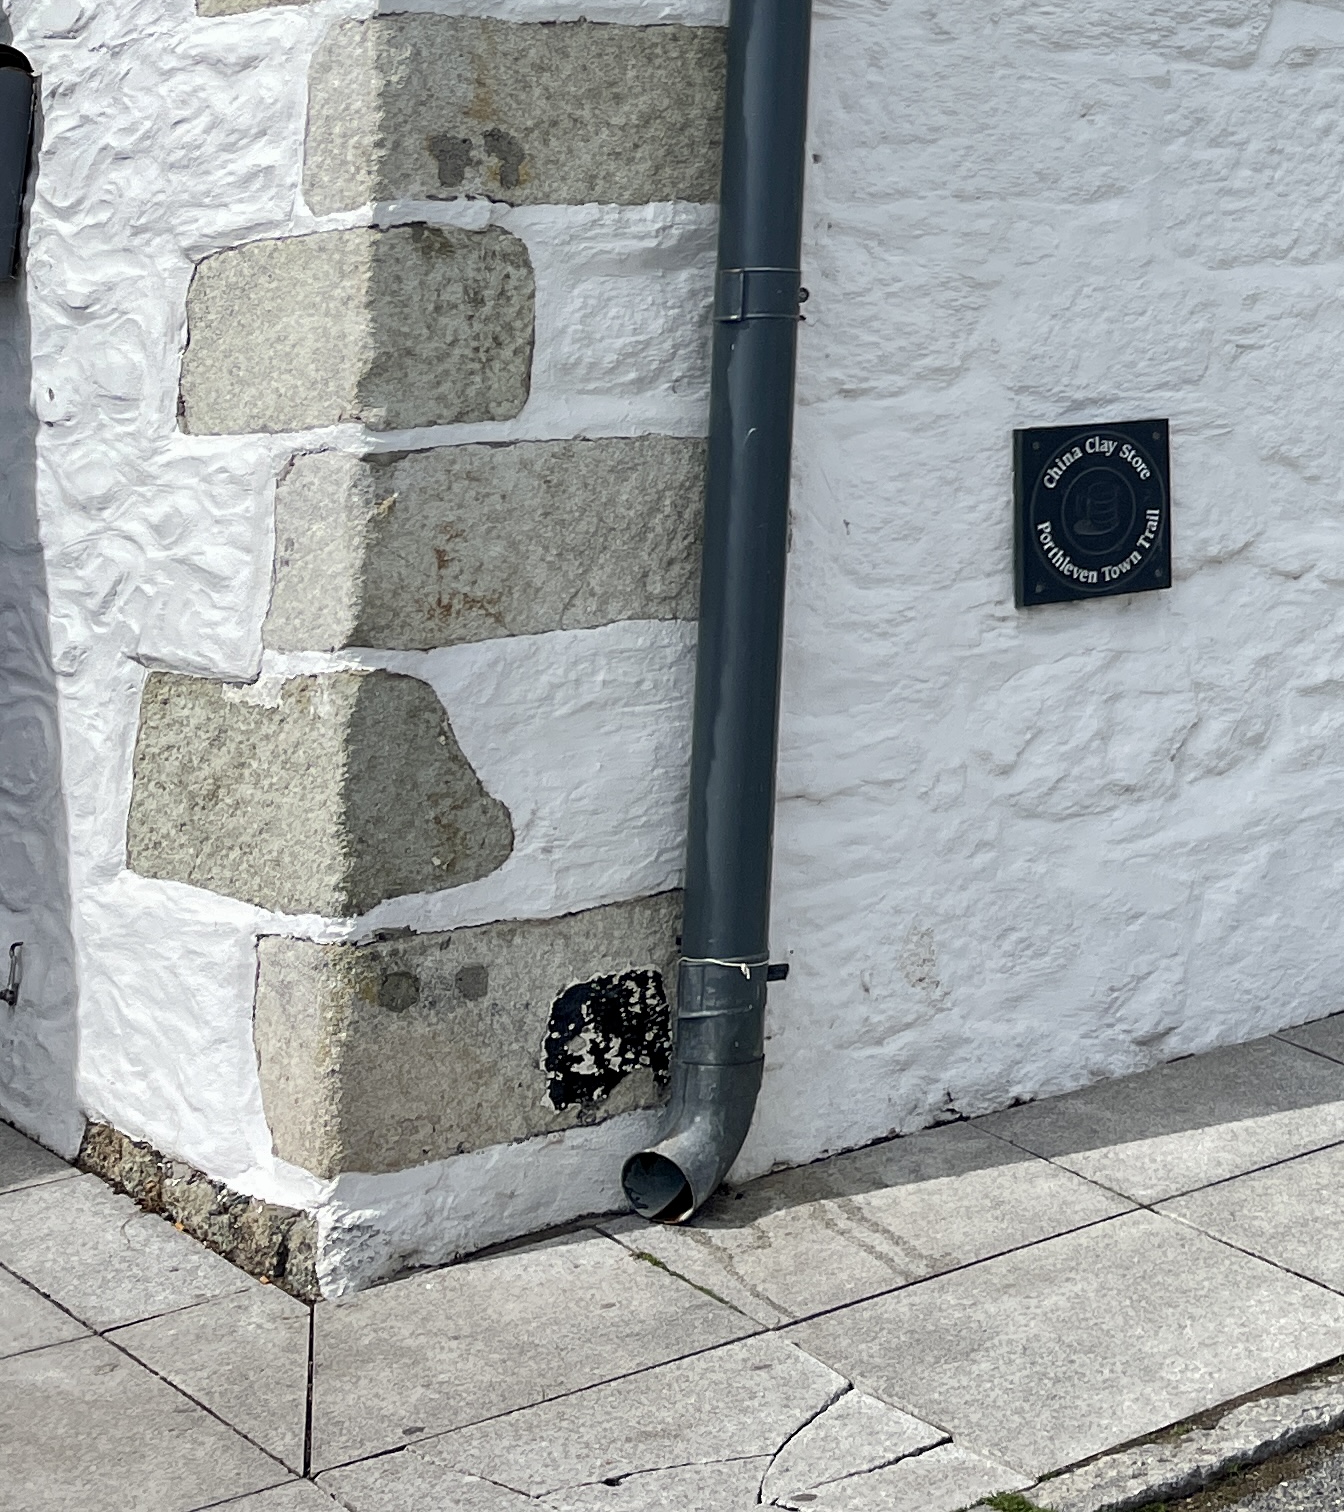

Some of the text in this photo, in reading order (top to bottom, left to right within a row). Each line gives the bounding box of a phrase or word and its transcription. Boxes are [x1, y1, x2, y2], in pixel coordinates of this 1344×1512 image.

[1043, 436, 1151, 488] China Clay Store
[1037, 509, 1160, 583] Porthleven Town Trail
